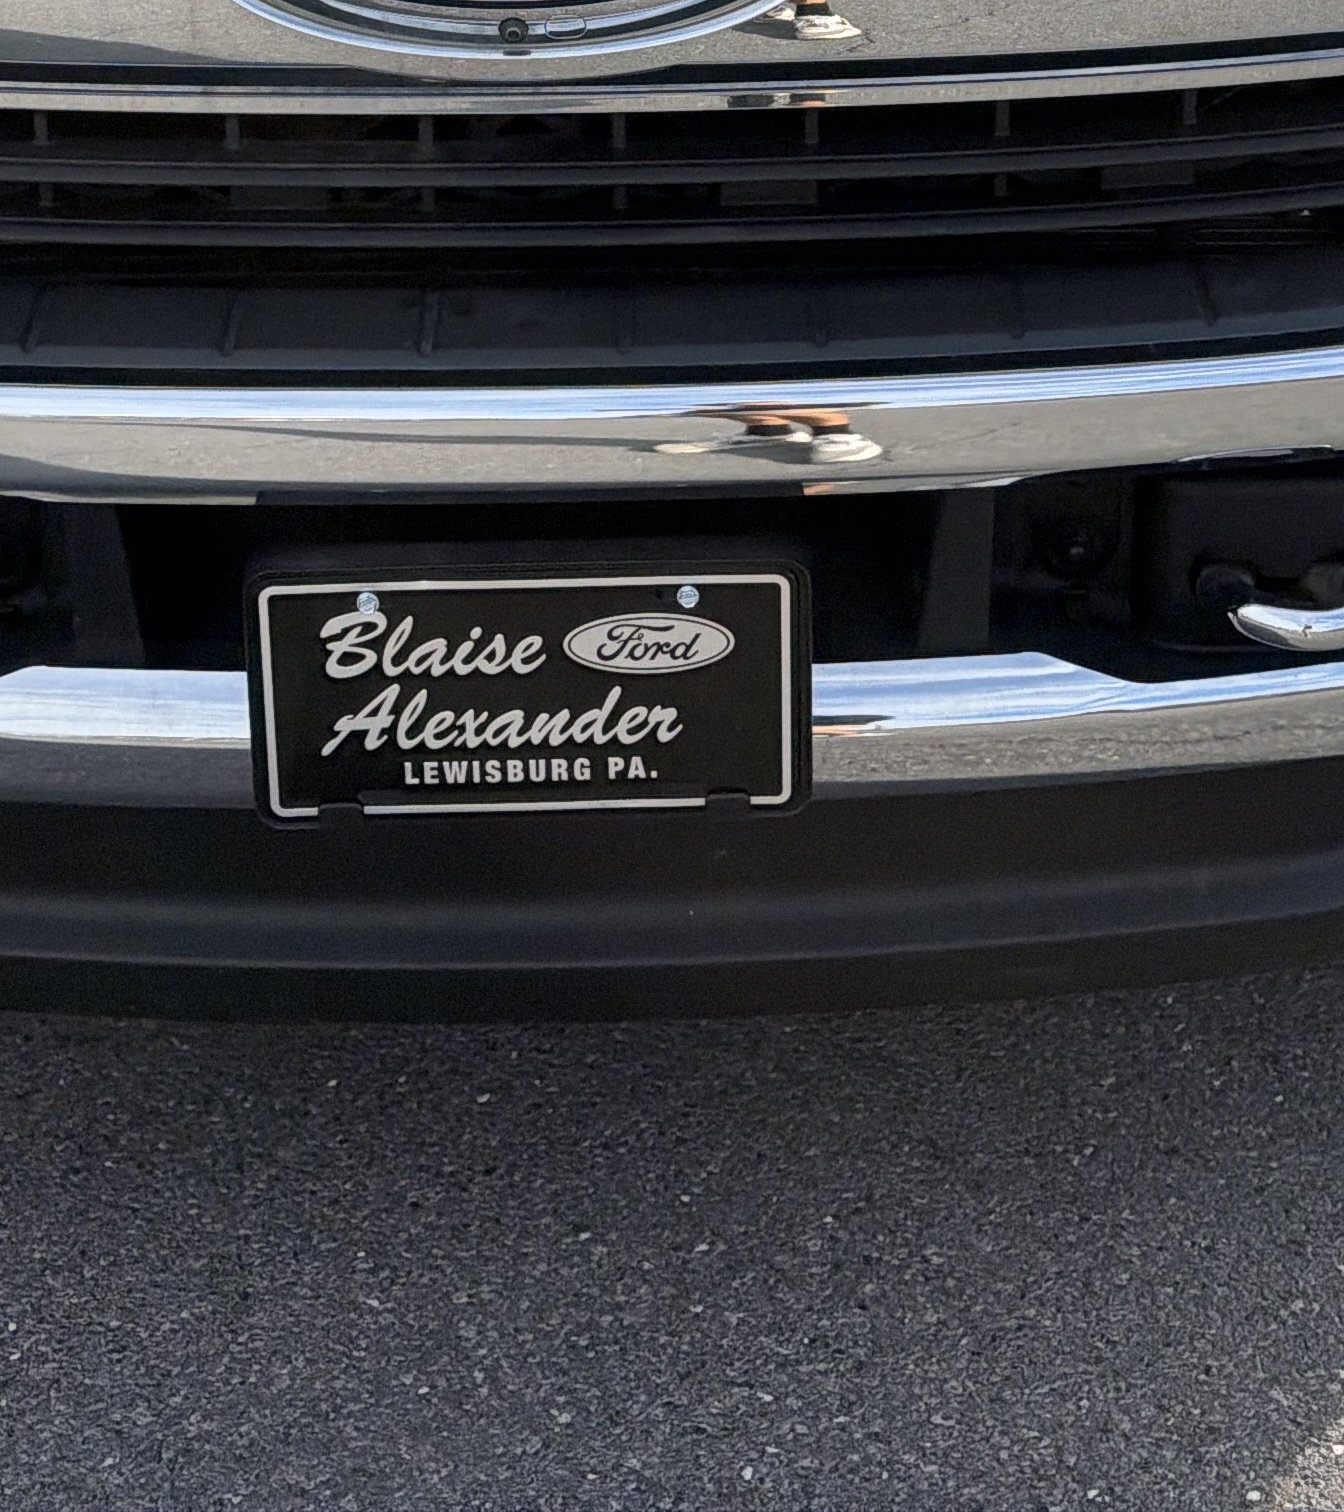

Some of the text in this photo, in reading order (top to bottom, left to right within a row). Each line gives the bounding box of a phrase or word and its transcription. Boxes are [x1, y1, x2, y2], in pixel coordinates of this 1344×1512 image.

[319, 611, 699, 678] Blaise Ford
[320, 684, 683, 756] Alexander
[404, 756, 658, 785] LEWISBURG PA.
